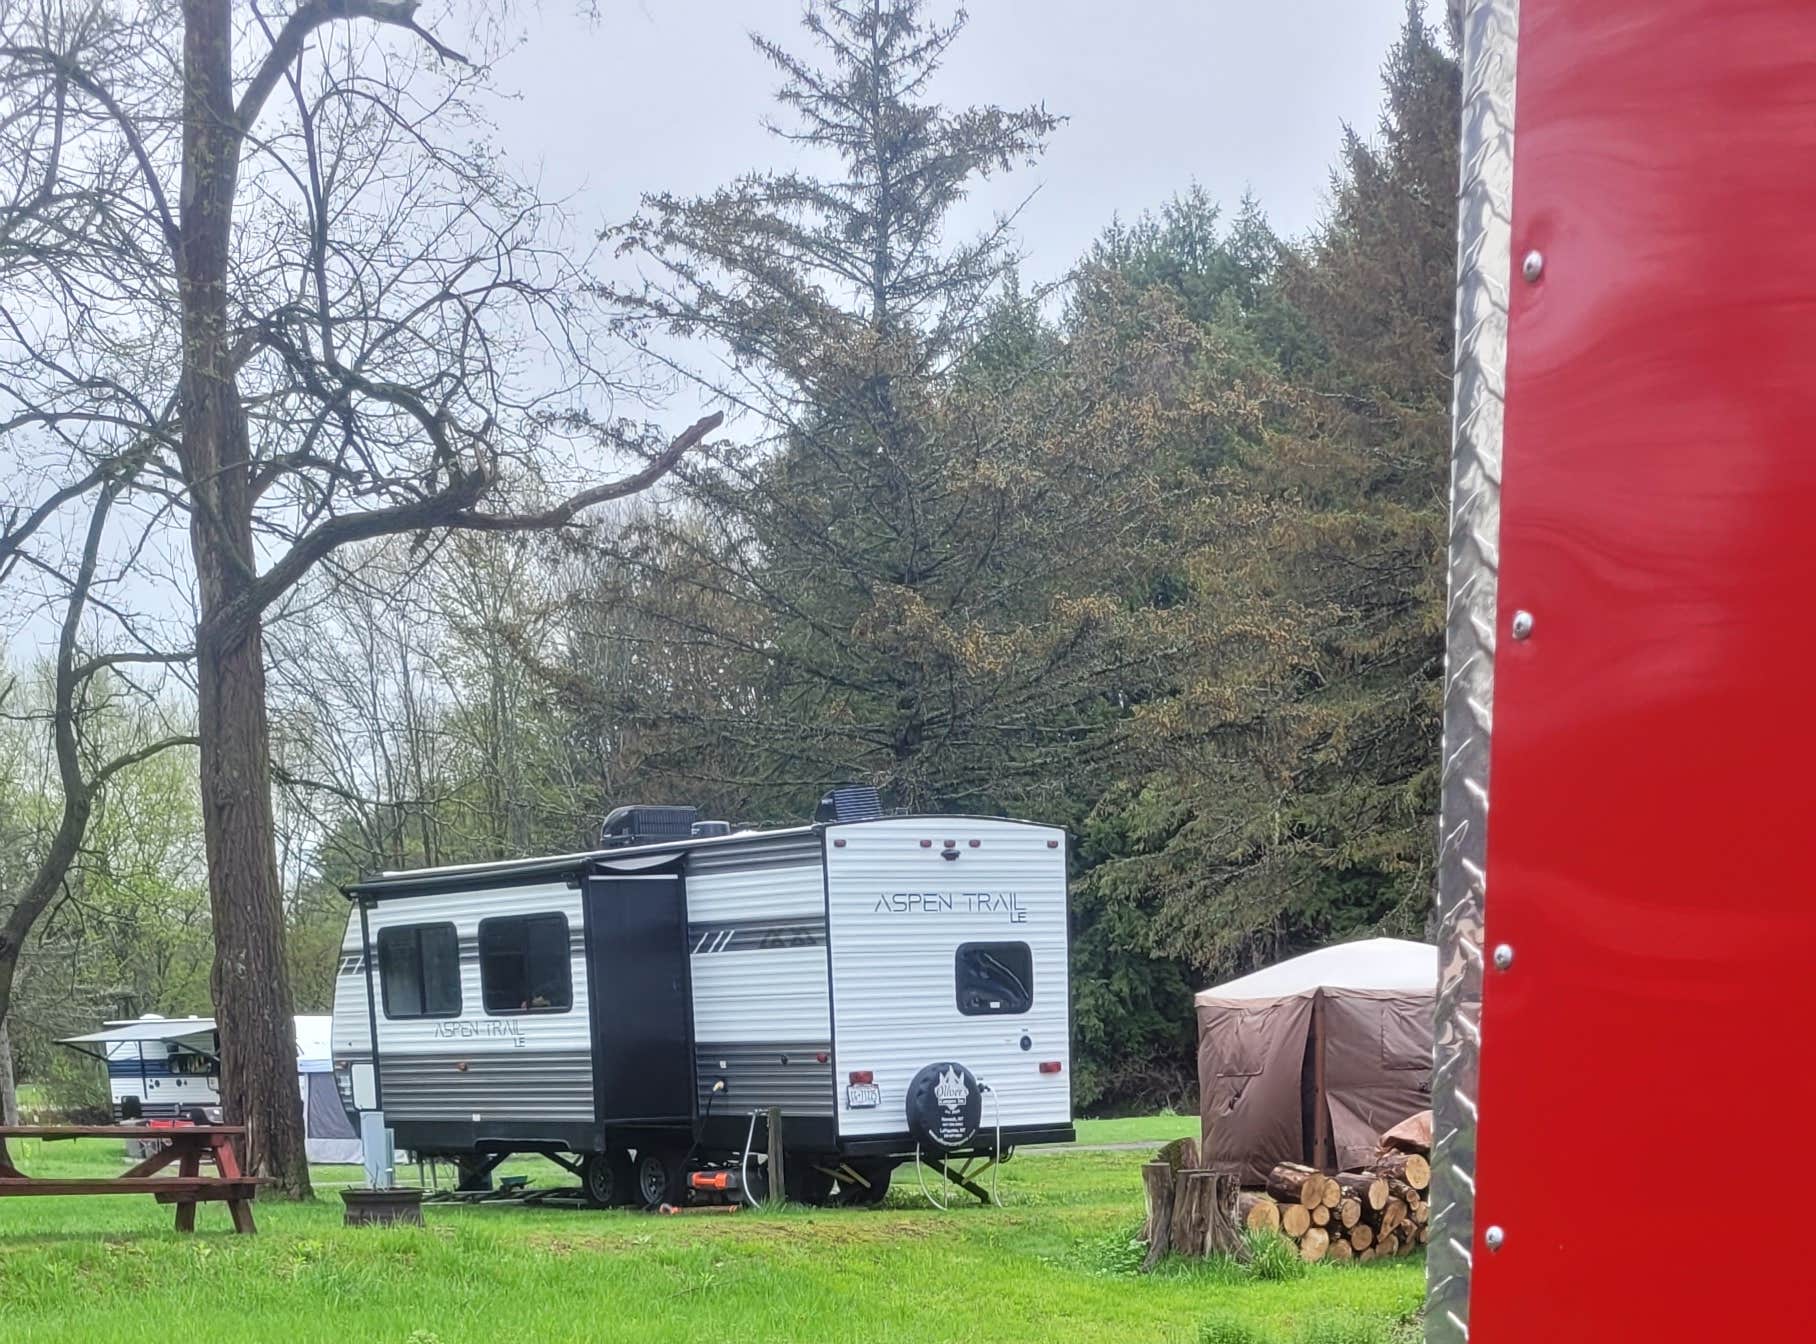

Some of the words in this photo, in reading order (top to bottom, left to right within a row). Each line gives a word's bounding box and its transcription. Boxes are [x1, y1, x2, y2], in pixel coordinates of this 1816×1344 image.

[874, 892, 953, 912] ASPEN
[962, 891, 1027, 911] TRAIL
[1010, 911, 1028, 923] LE
[434, 1020, 480, 1038] ASPEN
[482, 1019, 525, 1036] TRAIL
[514, 1037, 526, 1048] LE
